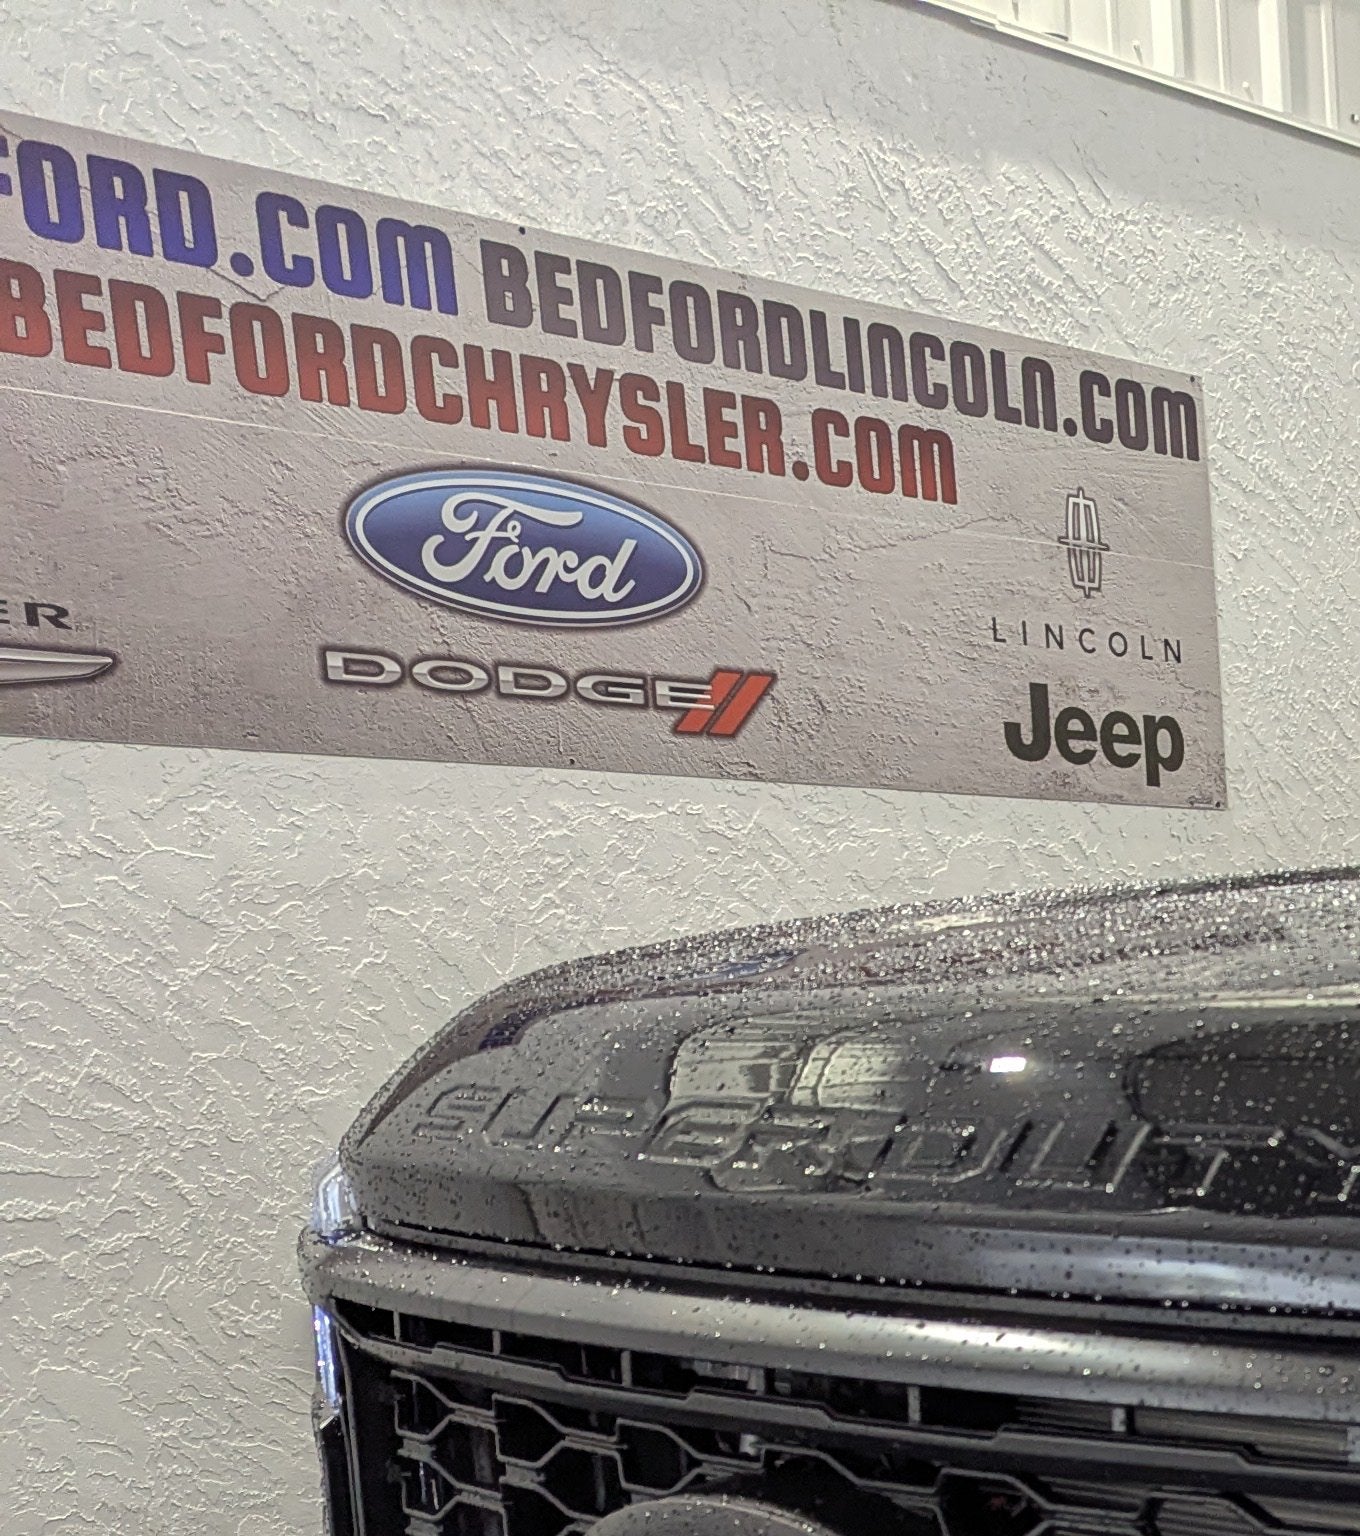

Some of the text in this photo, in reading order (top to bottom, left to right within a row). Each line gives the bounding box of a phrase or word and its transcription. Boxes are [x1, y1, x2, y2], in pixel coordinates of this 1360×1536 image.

[0, 133, 1201, 462] ORD.COM BEDFORDLINCOLN.COM
[0, 257, 958, 505] BEDFORDCHRYSLER.COM
[420, 490, 639, 604] Ford
[321, 647, 716, 712] DODGE
[991, 616, 1183, 664] LINCOLN
[1003, 680, 1186, 787] Jeep
